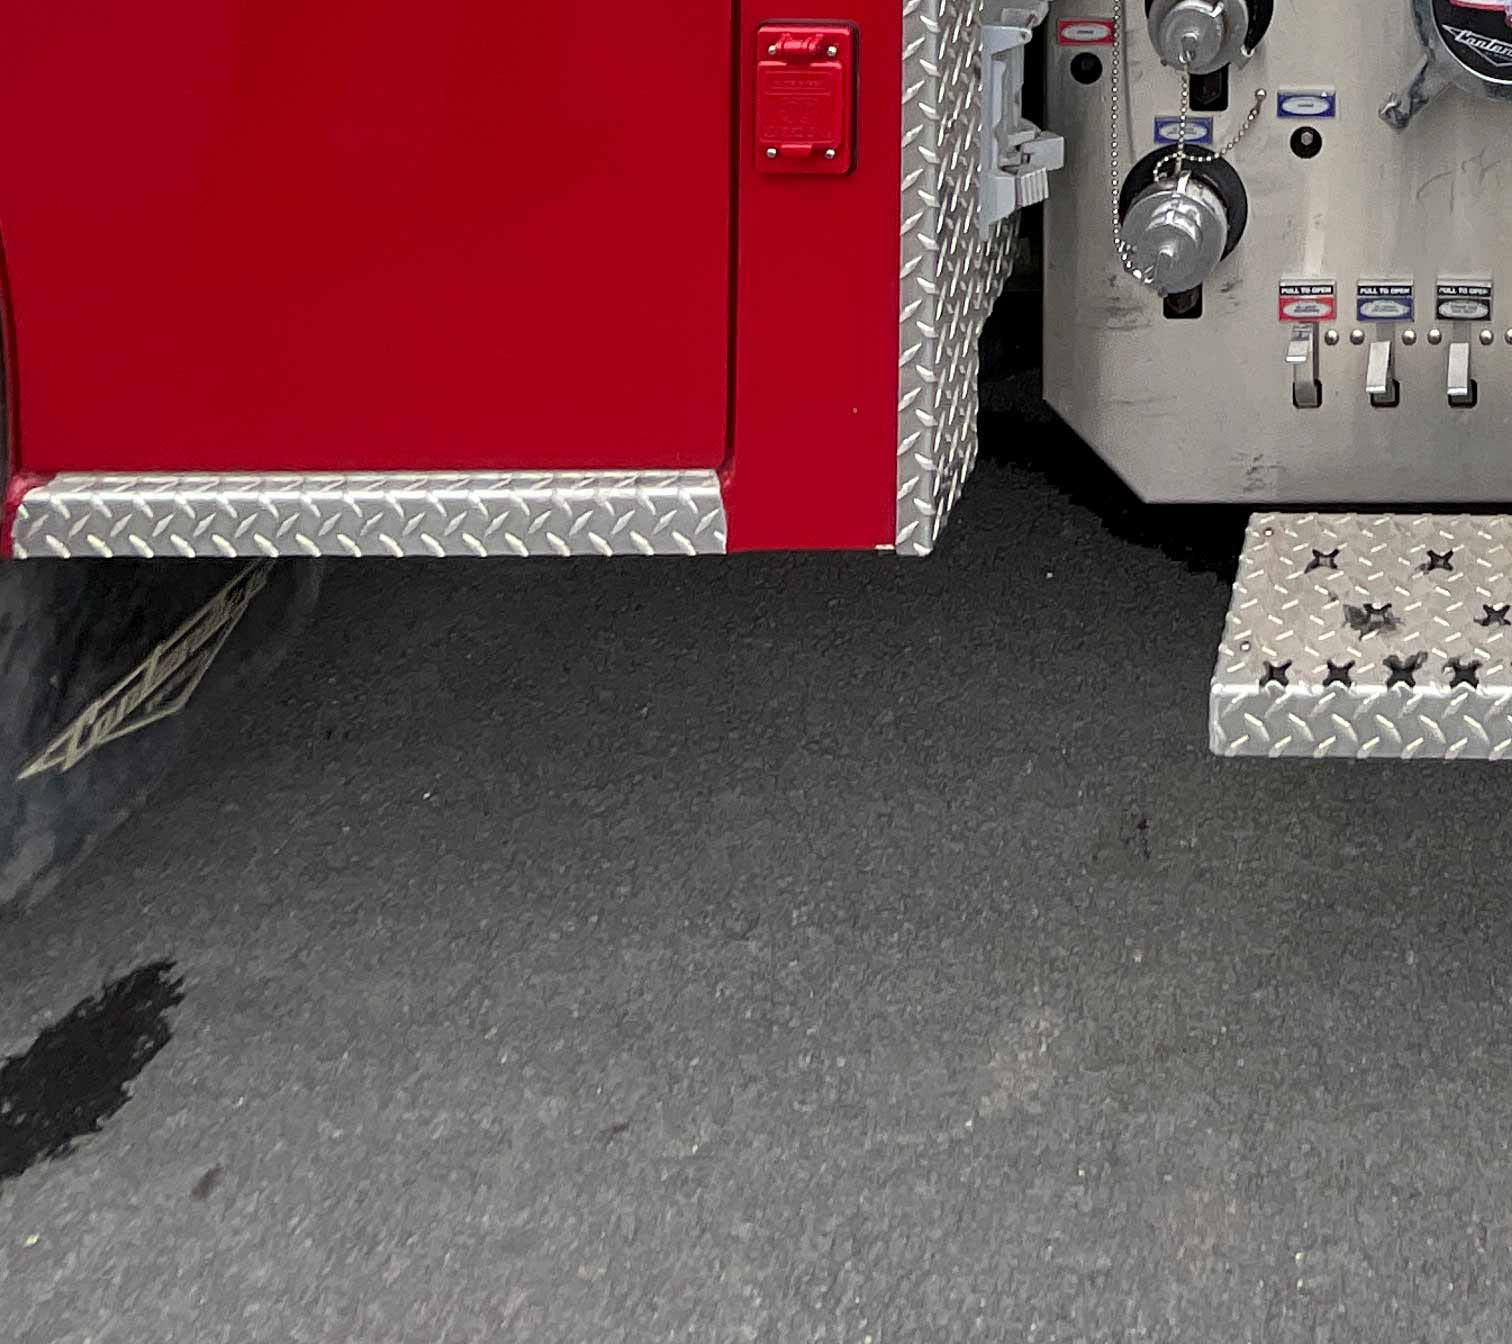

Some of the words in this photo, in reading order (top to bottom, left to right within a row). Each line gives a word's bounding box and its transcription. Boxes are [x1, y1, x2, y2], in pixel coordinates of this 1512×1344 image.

[1311, 286, 1332, 294] OPEN
[1359, 287, 1378, 295] PULL
[1378, 287, 1389, 295] TO
